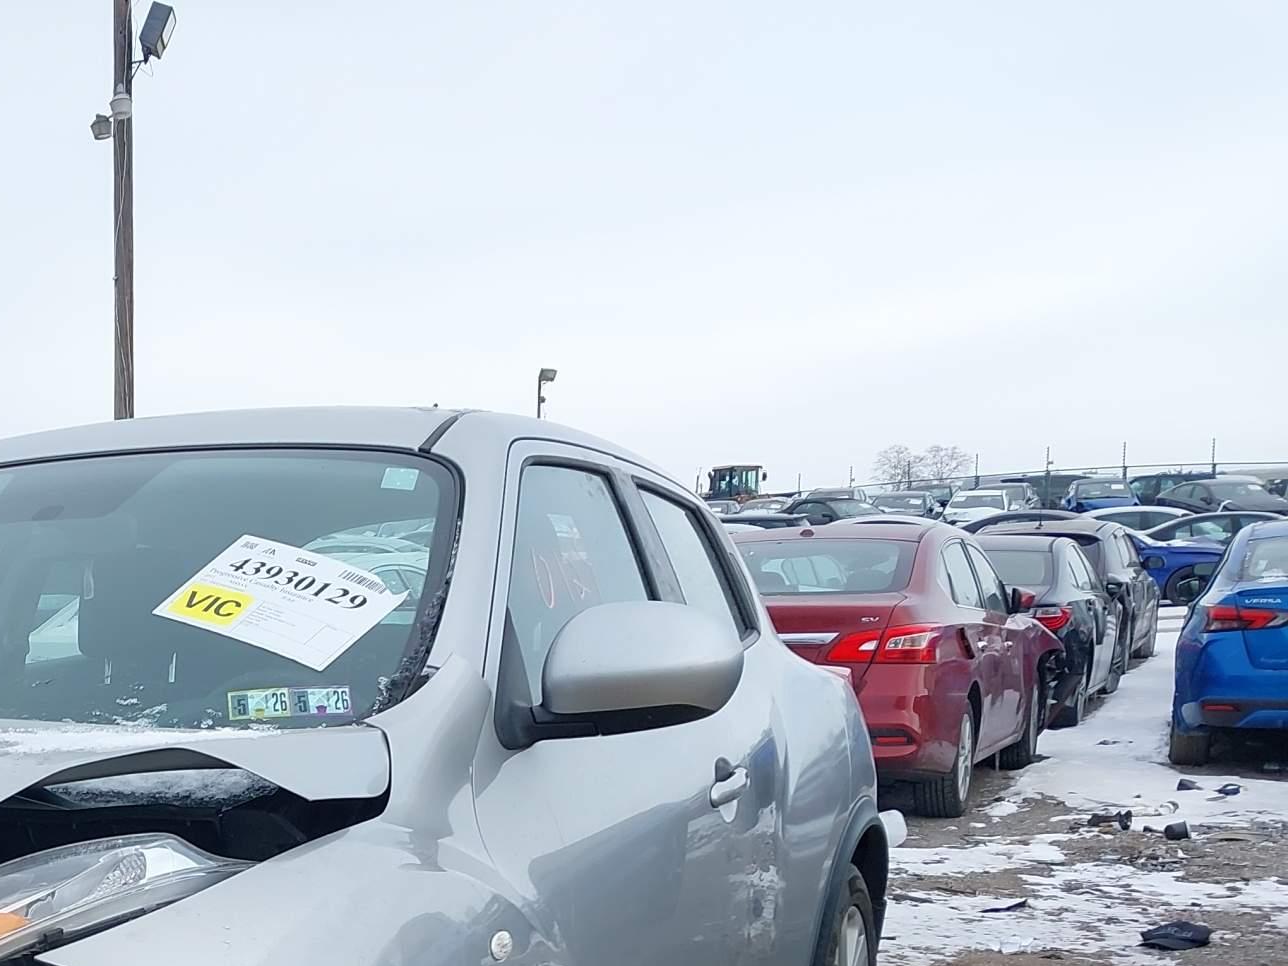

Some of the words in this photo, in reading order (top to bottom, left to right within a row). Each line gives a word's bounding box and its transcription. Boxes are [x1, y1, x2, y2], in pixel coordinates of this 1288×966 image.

[228, 558, 368, 609] 43930129
[185, 590, 242, 617] VIC
[237, 698, 247, 716] 5
[271, 692, 288, 713] 26
[297, 695, 308, 713] 5
[333, 690, 349, 711] 26
